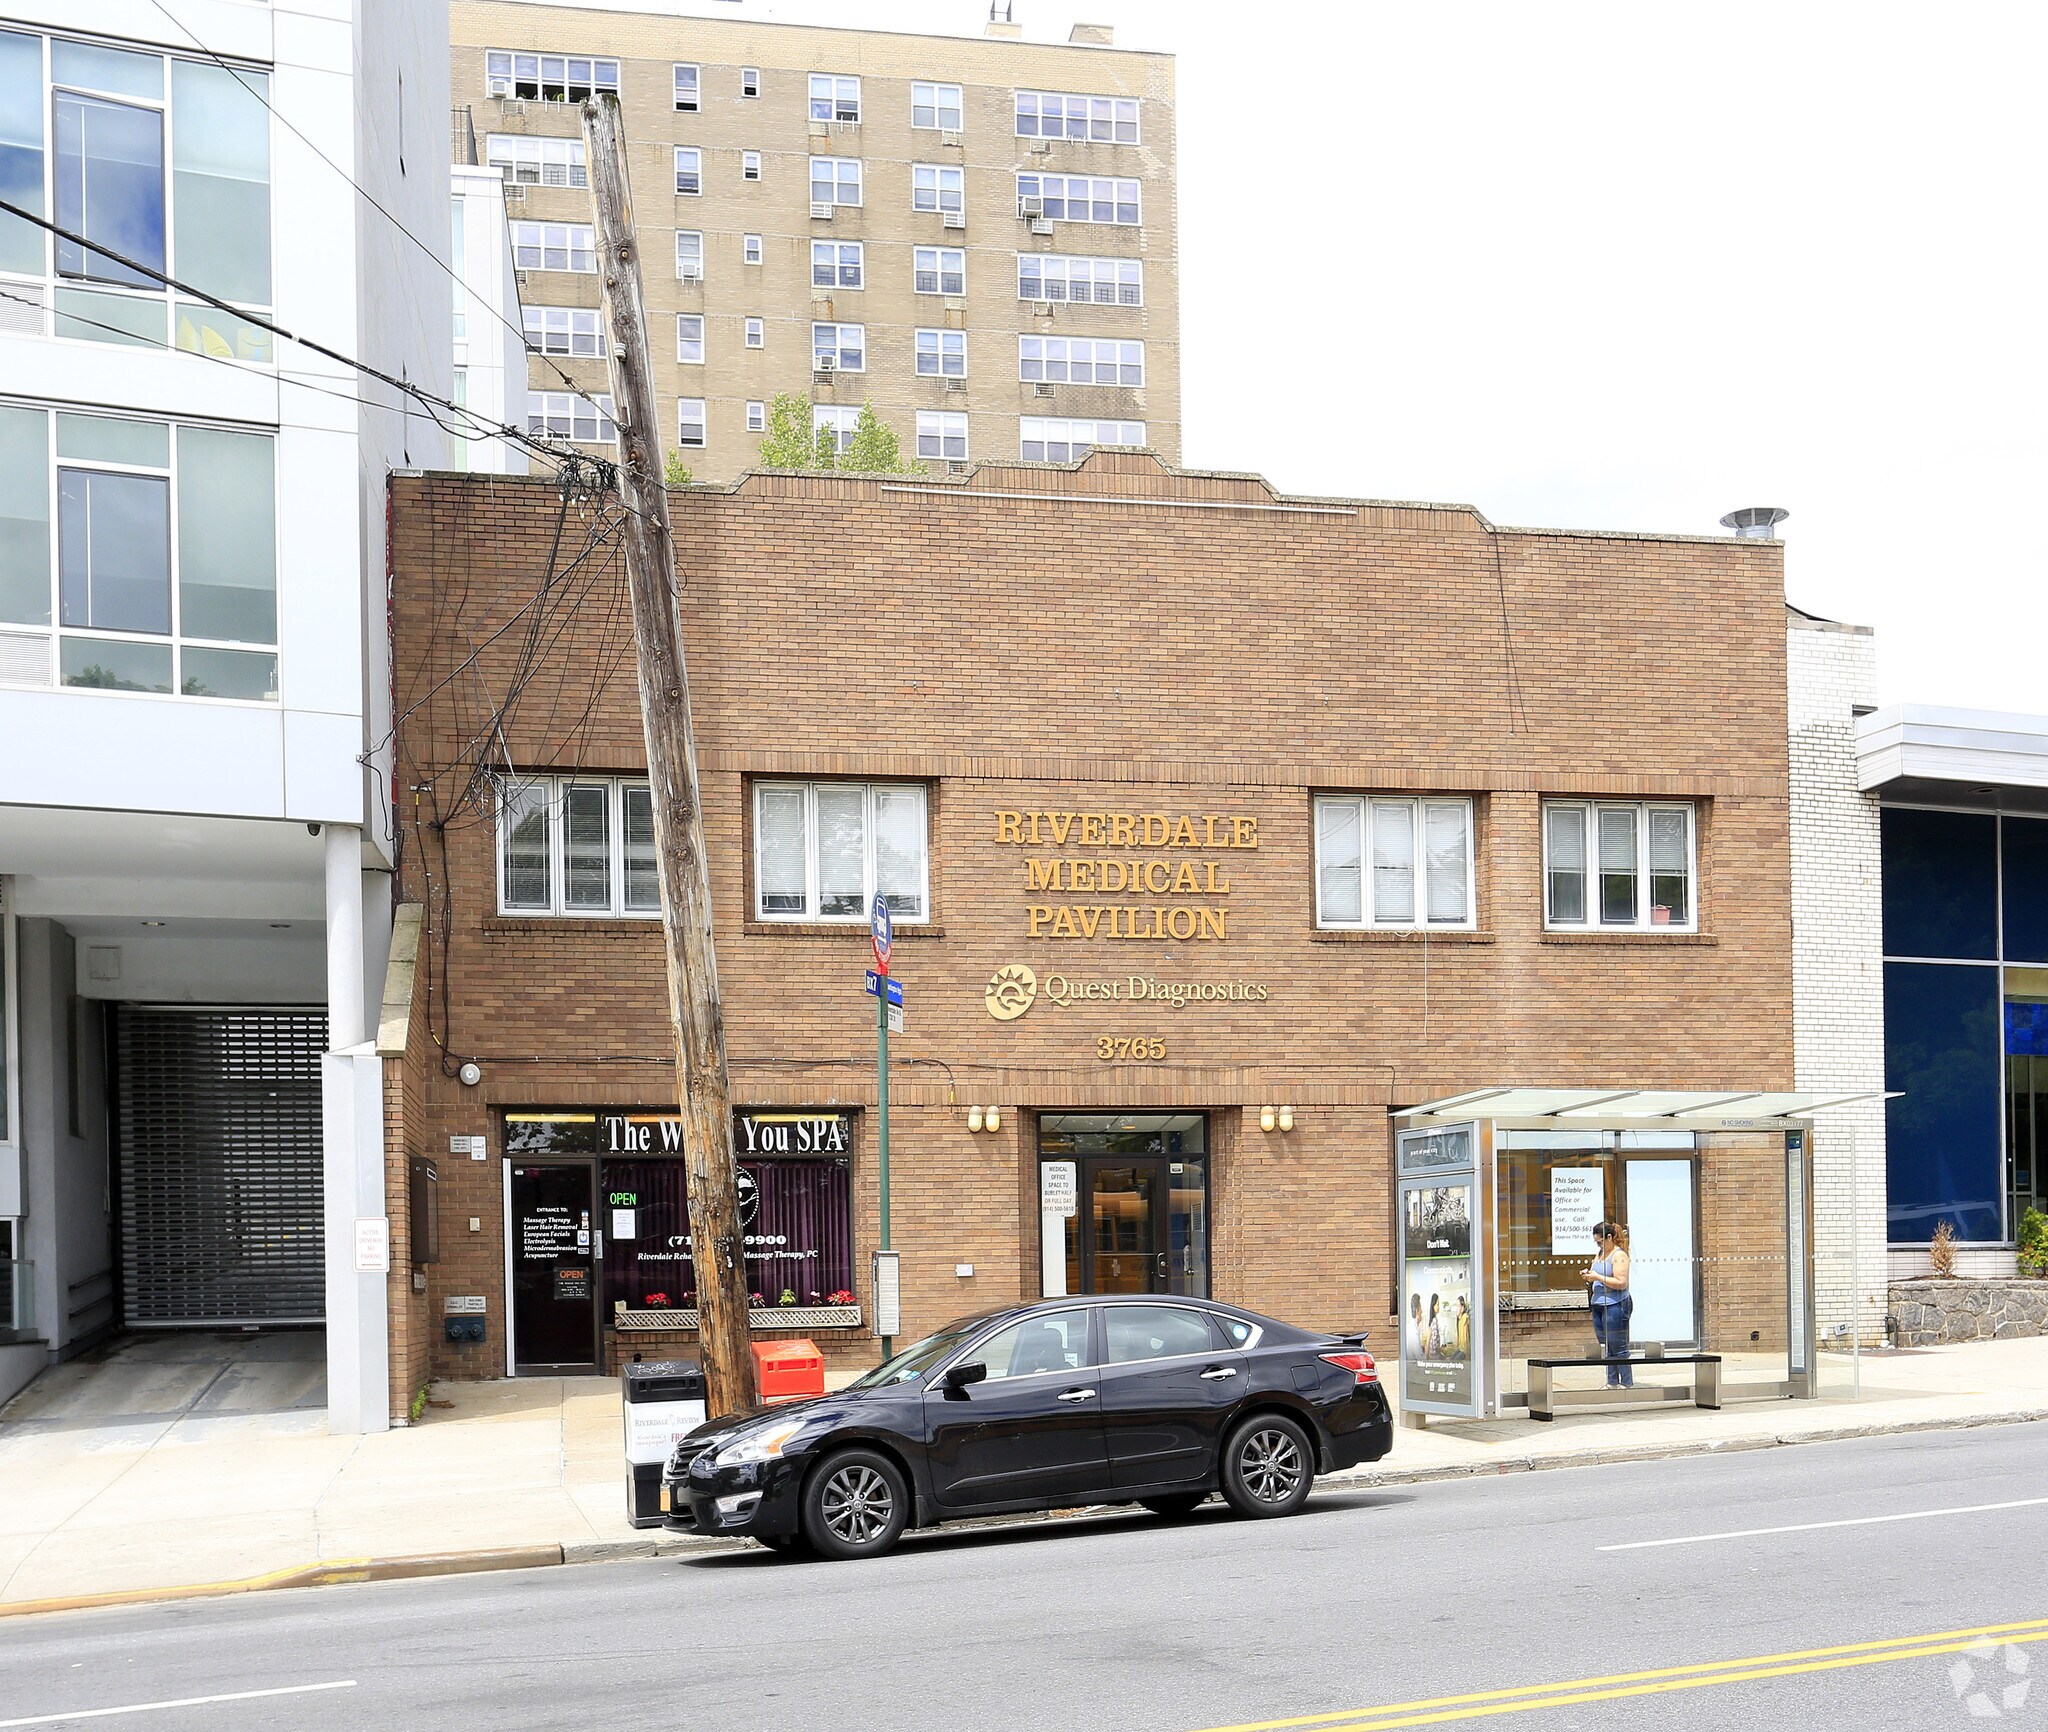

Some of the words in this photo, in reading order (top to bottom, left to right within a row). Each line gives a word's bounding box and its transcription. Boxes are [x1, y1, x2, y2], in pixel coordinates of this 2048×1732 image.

[995, 811, 1258, 849] RIVERDALE
[1024, 858, 1230, 894] MEDICAL
[1026, 905, 1230, 940] PAVILION
[1045, 975, 1121, 1007] Quest
[1127, 976, 1268, 1008] Diagnostics
[1096, 1036, 1167, 1060] 3765
[605, 1116, 651, 1151] The
[742, 1117, 789, 1151] You
[797, 1117, 844, 1151] SPA
[609, 1192, 637, 1206] OPEN
[638, 1252, 672, 1260] Riverdale
[774, 1250, 805, 1260] Therapy,
[806, 1250, 818, 1258] PC
[560, 1270, 584, 1278] OPEN
[634, 1418, 668, 1426] RIVERDALE
[671, 1432, 687, 1442] FRE
